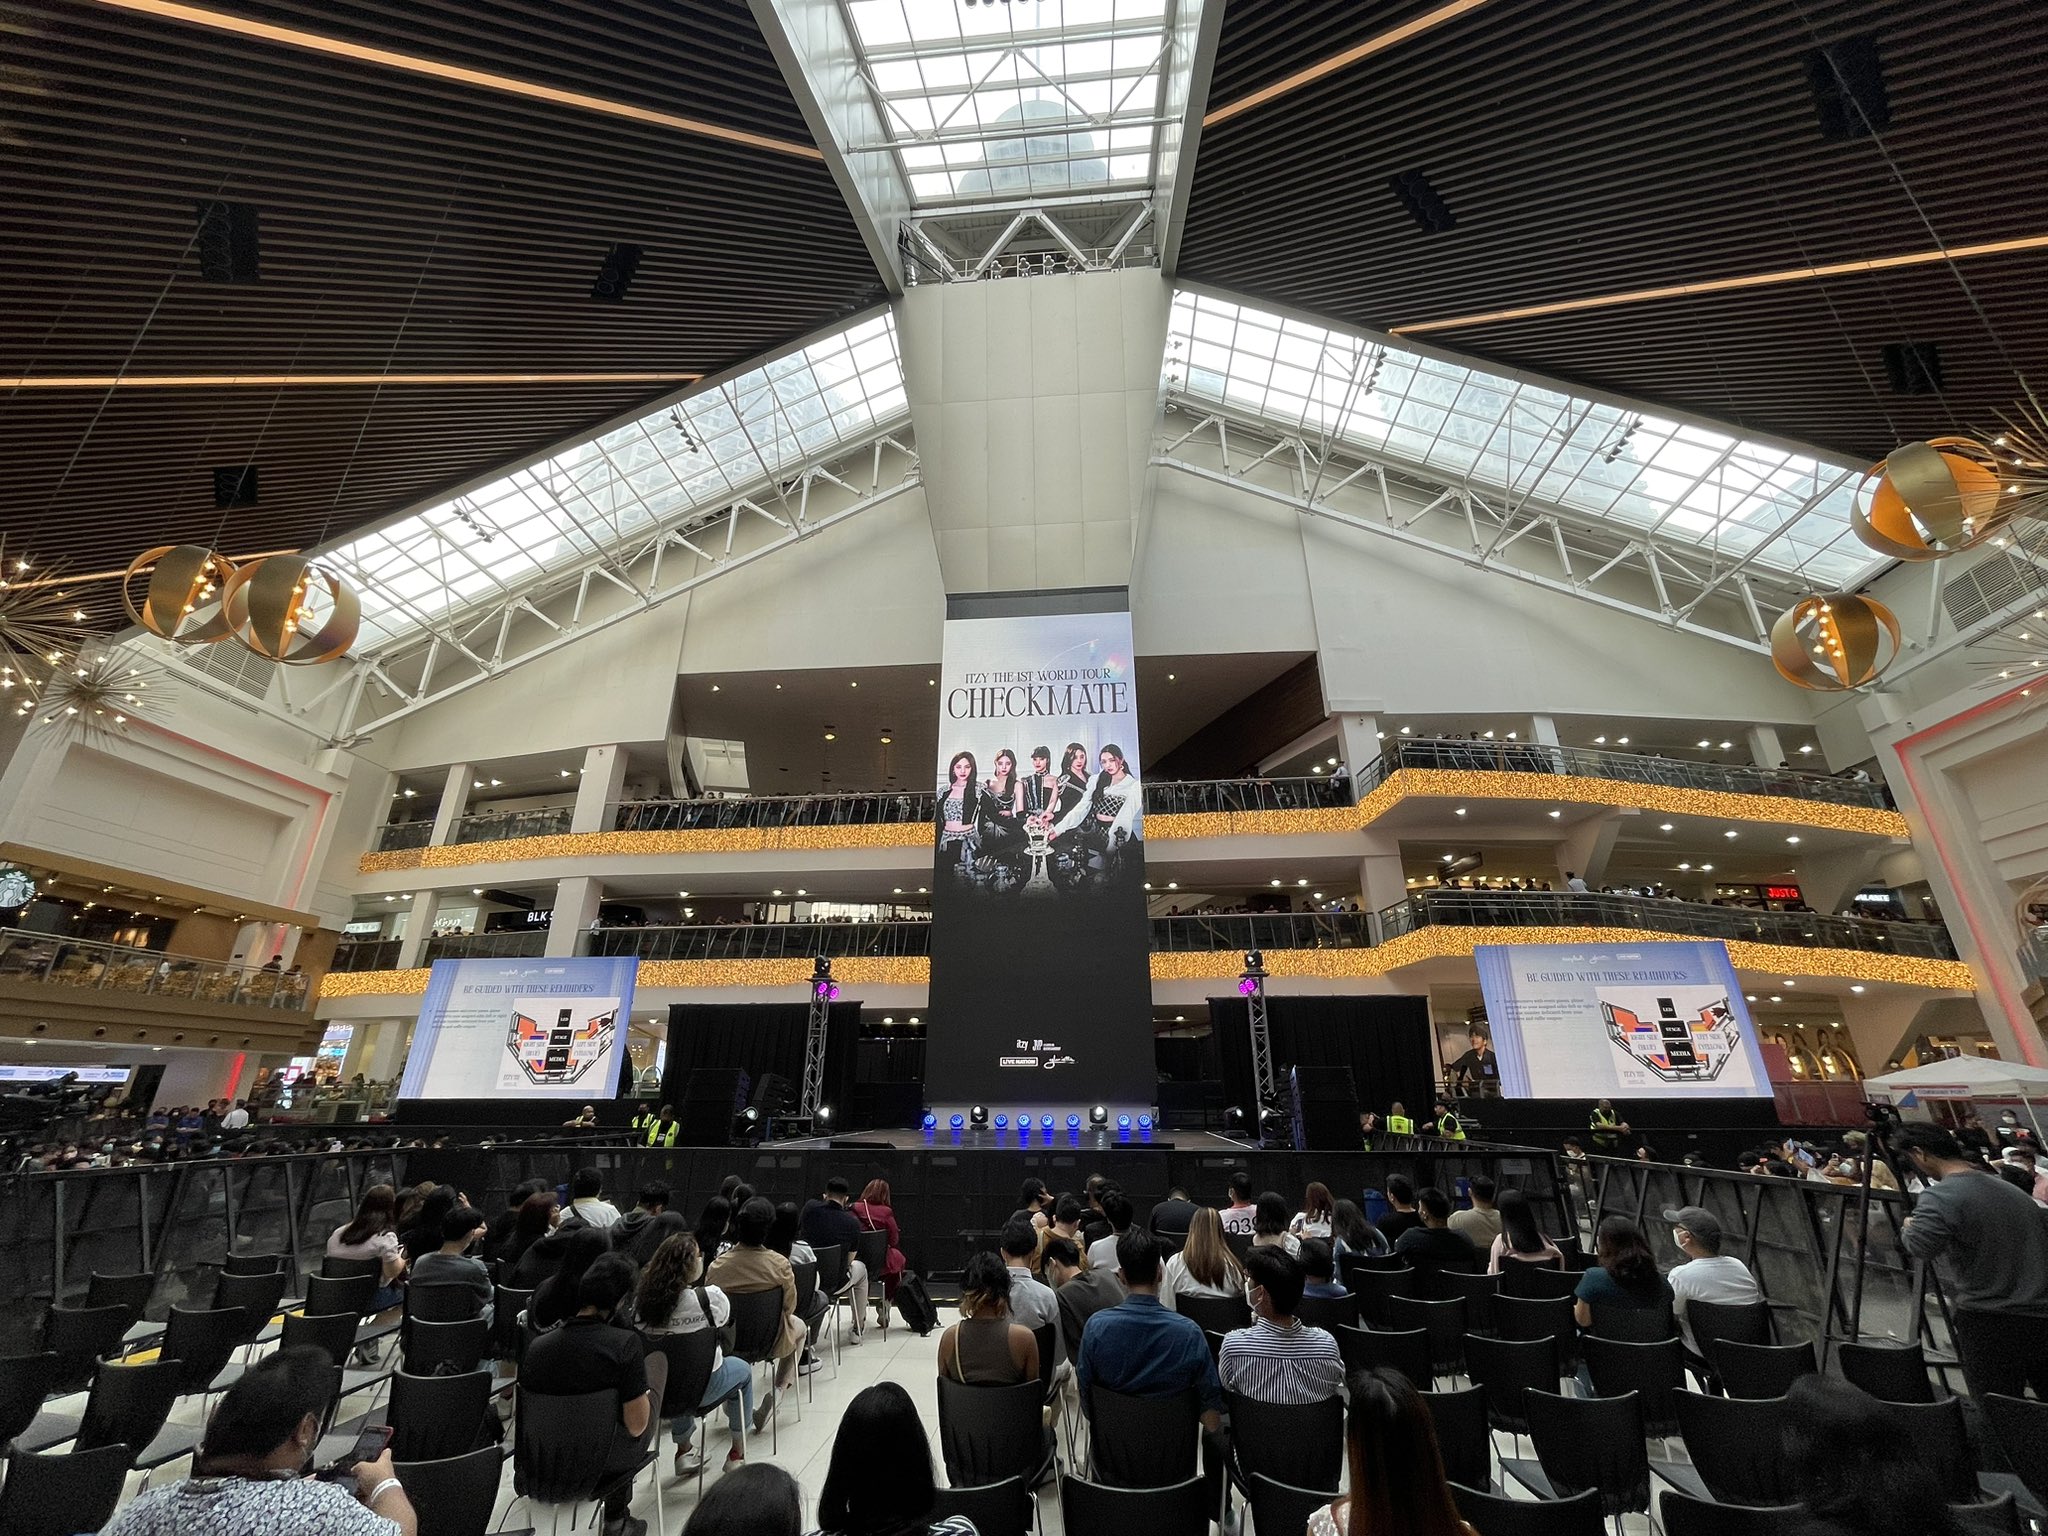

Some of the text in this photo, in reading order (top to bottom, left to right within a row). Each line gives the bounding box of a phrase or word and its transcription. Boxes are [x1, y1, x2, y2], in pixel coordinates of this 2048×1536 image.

[965, 672, 989, 684] ITZY
[992, 672, 1014, 683] THE
[1037, 669, 1078, 681] WORLD
[1080, 668, 1111, 680] TOUR
[947, 682, 1128, 719] CHECKMATE
[527, 911, 548, 922] BLK
[1526, 973, 1539, 983] BE
[1541, 972, 1574, 982] GUIDED
[1575, 972, 1601, 982] WITH
[1602, 971, 1632, 981] THESE
